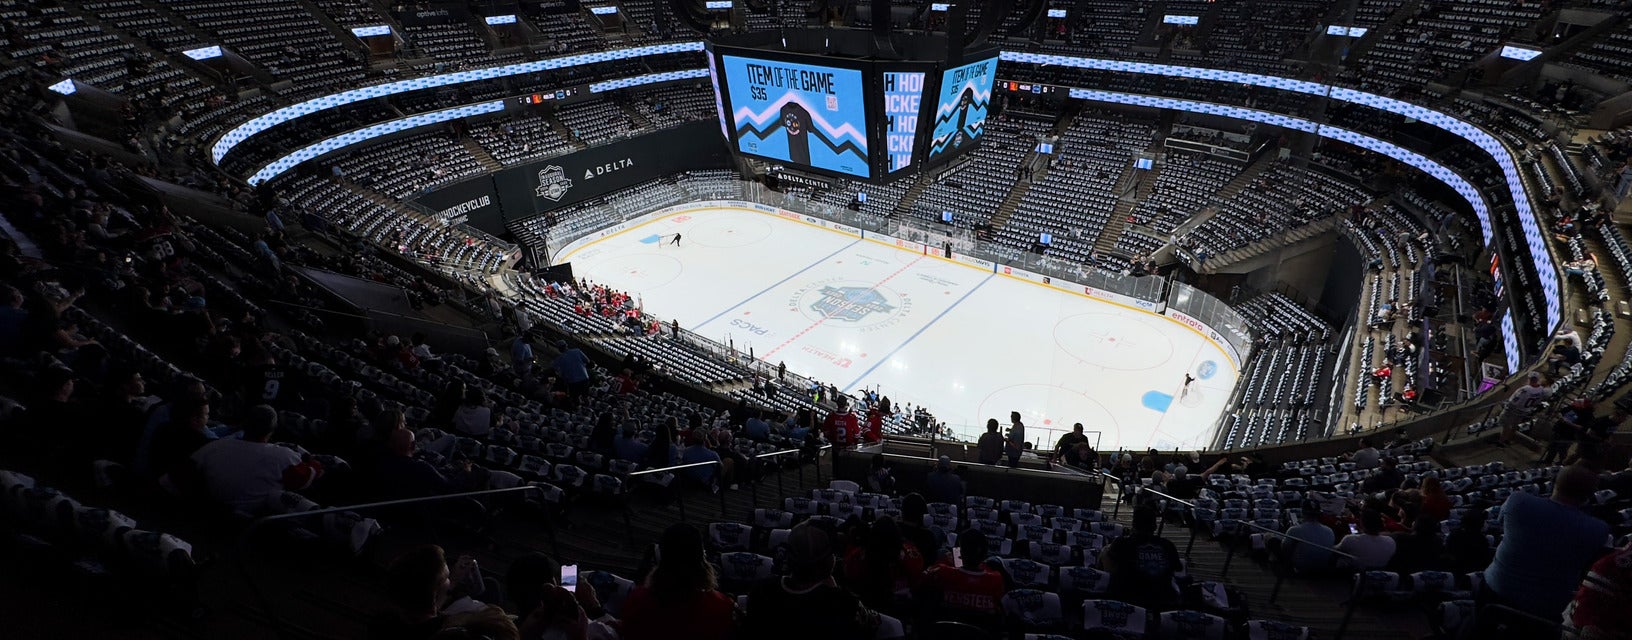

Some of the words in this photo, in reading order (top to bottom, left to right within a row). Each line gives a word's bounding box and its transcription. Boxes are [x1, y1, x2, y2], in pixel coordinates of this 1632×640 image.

[746, 64, 774, 86] ITEM
[774, 67, 784, 88] OF
[784, 68, 800, 90] THE
[800, 70, 836, 95] GAME
[952, 69, 965, 84] ITEM
[974, 62, 990, 78] GAME
[751, 85, 768, 101] $35
[596, 158, 634, 175] DELTA
[541, 176, 564, 187] SEASON
[783, 174, 804, 185] DELTA
[804, 178, 829, 189] CENTER
[822, 295, 871, 316] SEASON
[730, 318, 769, 336] PACS
[262, 379, 281, 401] 9
